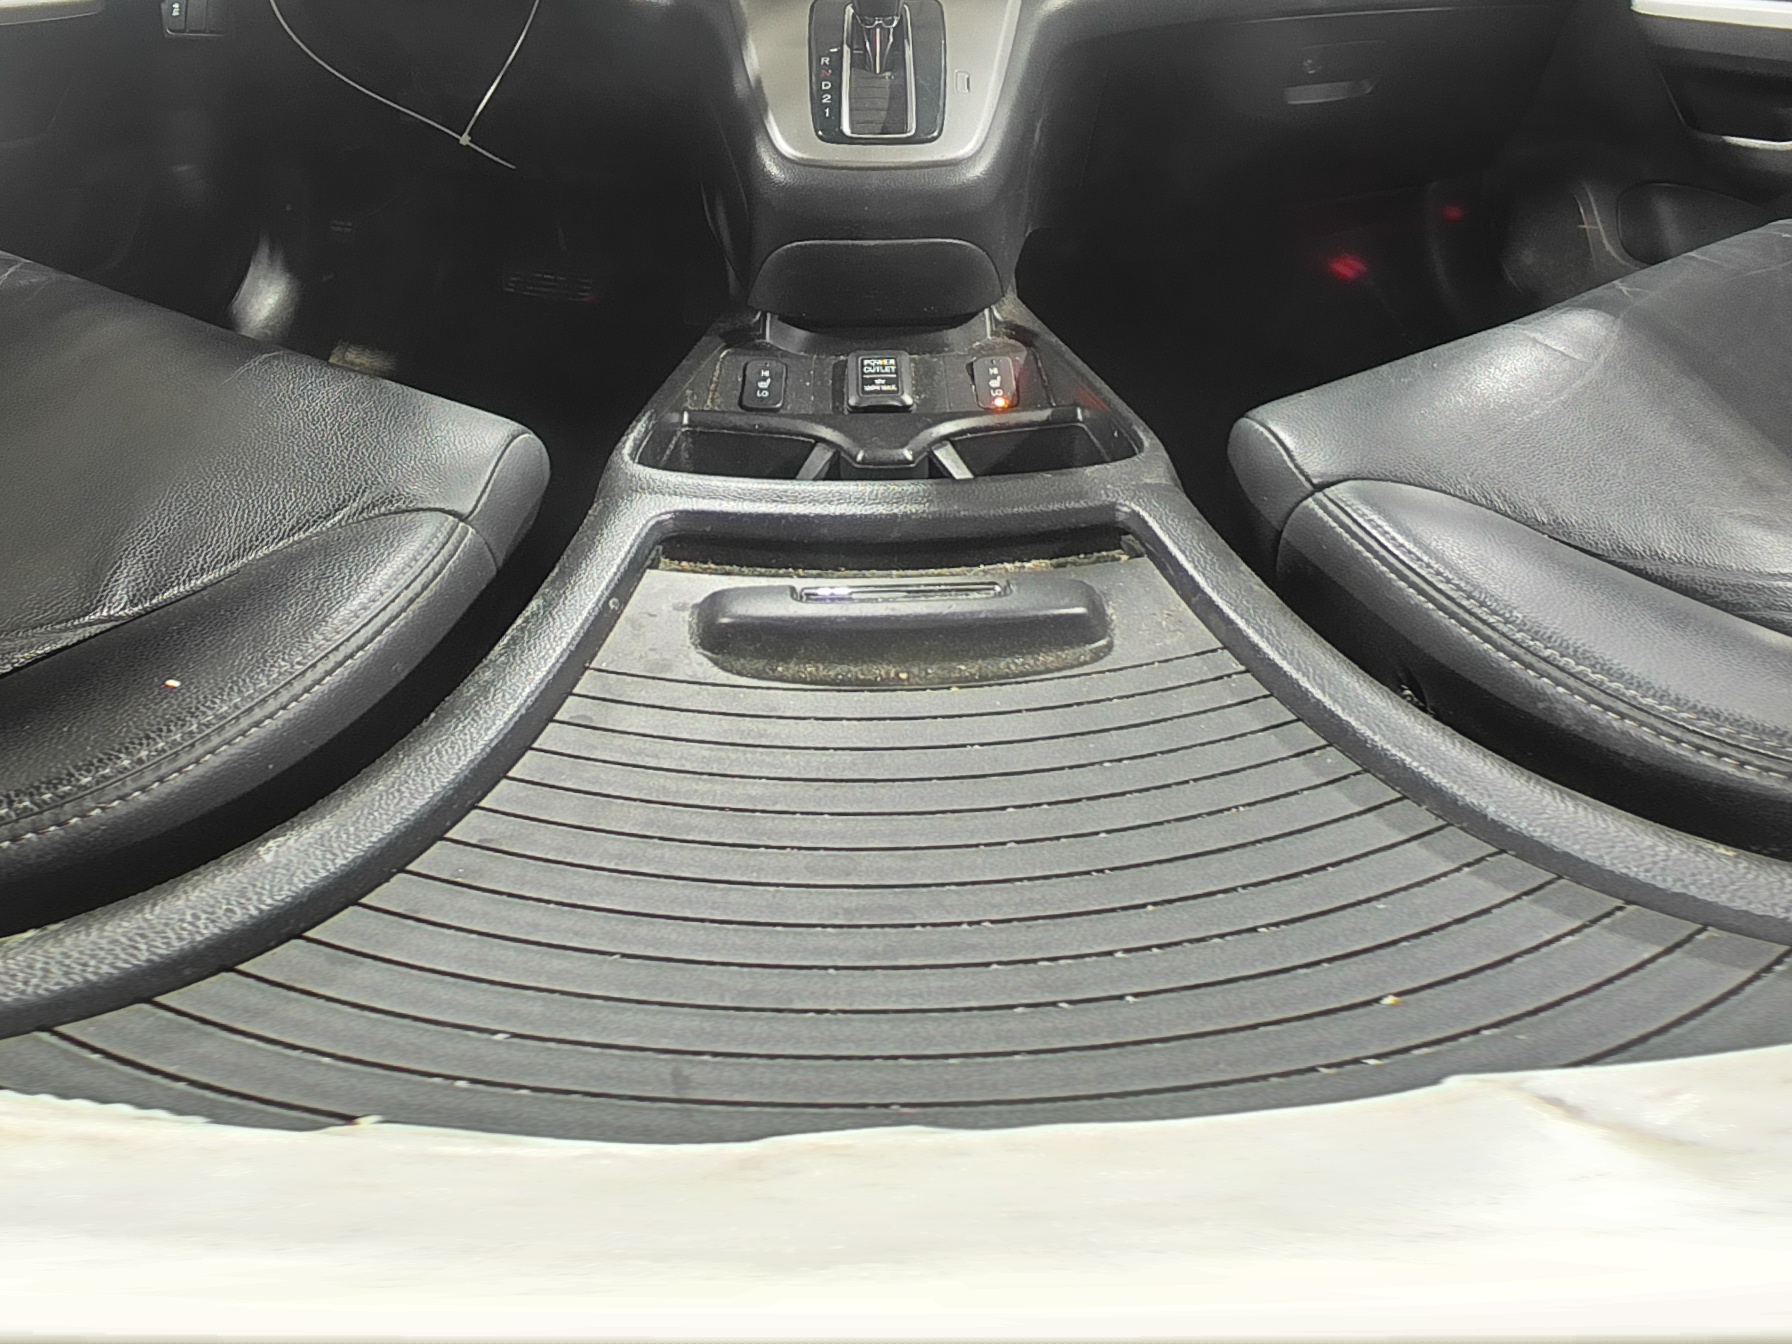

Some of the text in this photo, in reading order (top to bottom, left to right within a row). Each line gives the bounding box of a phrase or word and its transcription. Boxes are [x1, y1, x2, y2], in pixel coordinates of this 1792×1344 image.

[820, 57, 830, 65] R
[821, 81, 832, 90] D
[821, 94, 832, 103] 2
[825, 107, 830, 117] 1
[756, 389, 769, 397] LO
[990, 389, 1004, 397] LO
